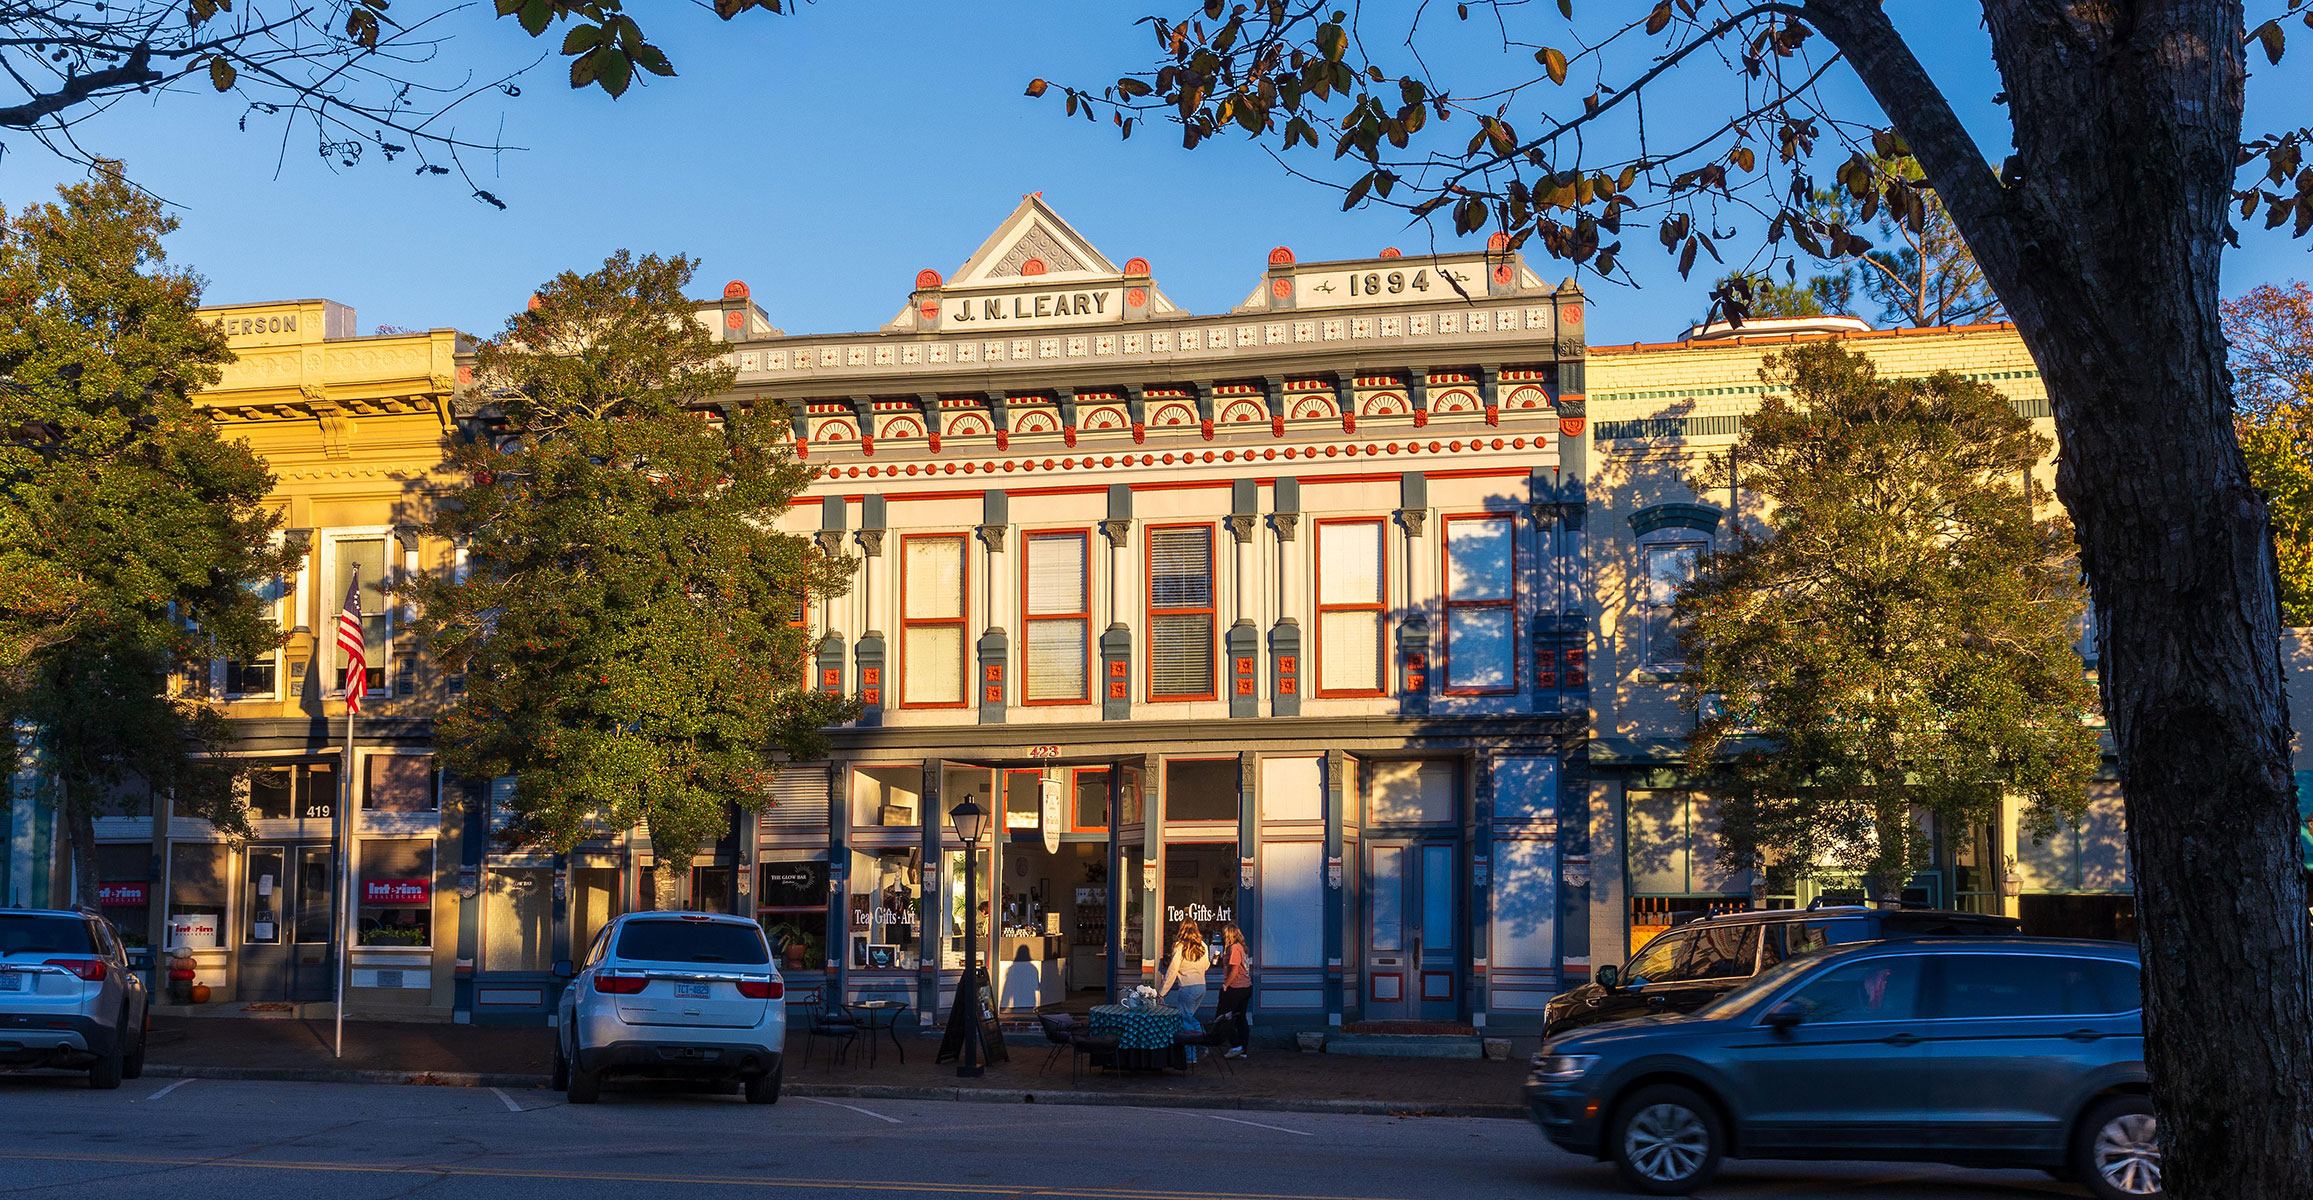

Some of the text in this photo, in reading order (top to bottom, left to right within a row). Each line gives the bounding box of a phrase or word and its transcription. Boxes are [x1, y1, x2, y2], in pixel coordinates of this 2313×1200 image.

[1350, 269, 1430, 297] 1894
[953, 291, 1109, 322] J. N. LEARY
[203, 315, 297, 336] ERSON
[1030, 745, 1059, 758] 423
[306, 805, 331, 818] 419
[854, 906, 915, 925] Tea Gifts Art
[1167, 902, 1232, 922] Tea Gifts Art
